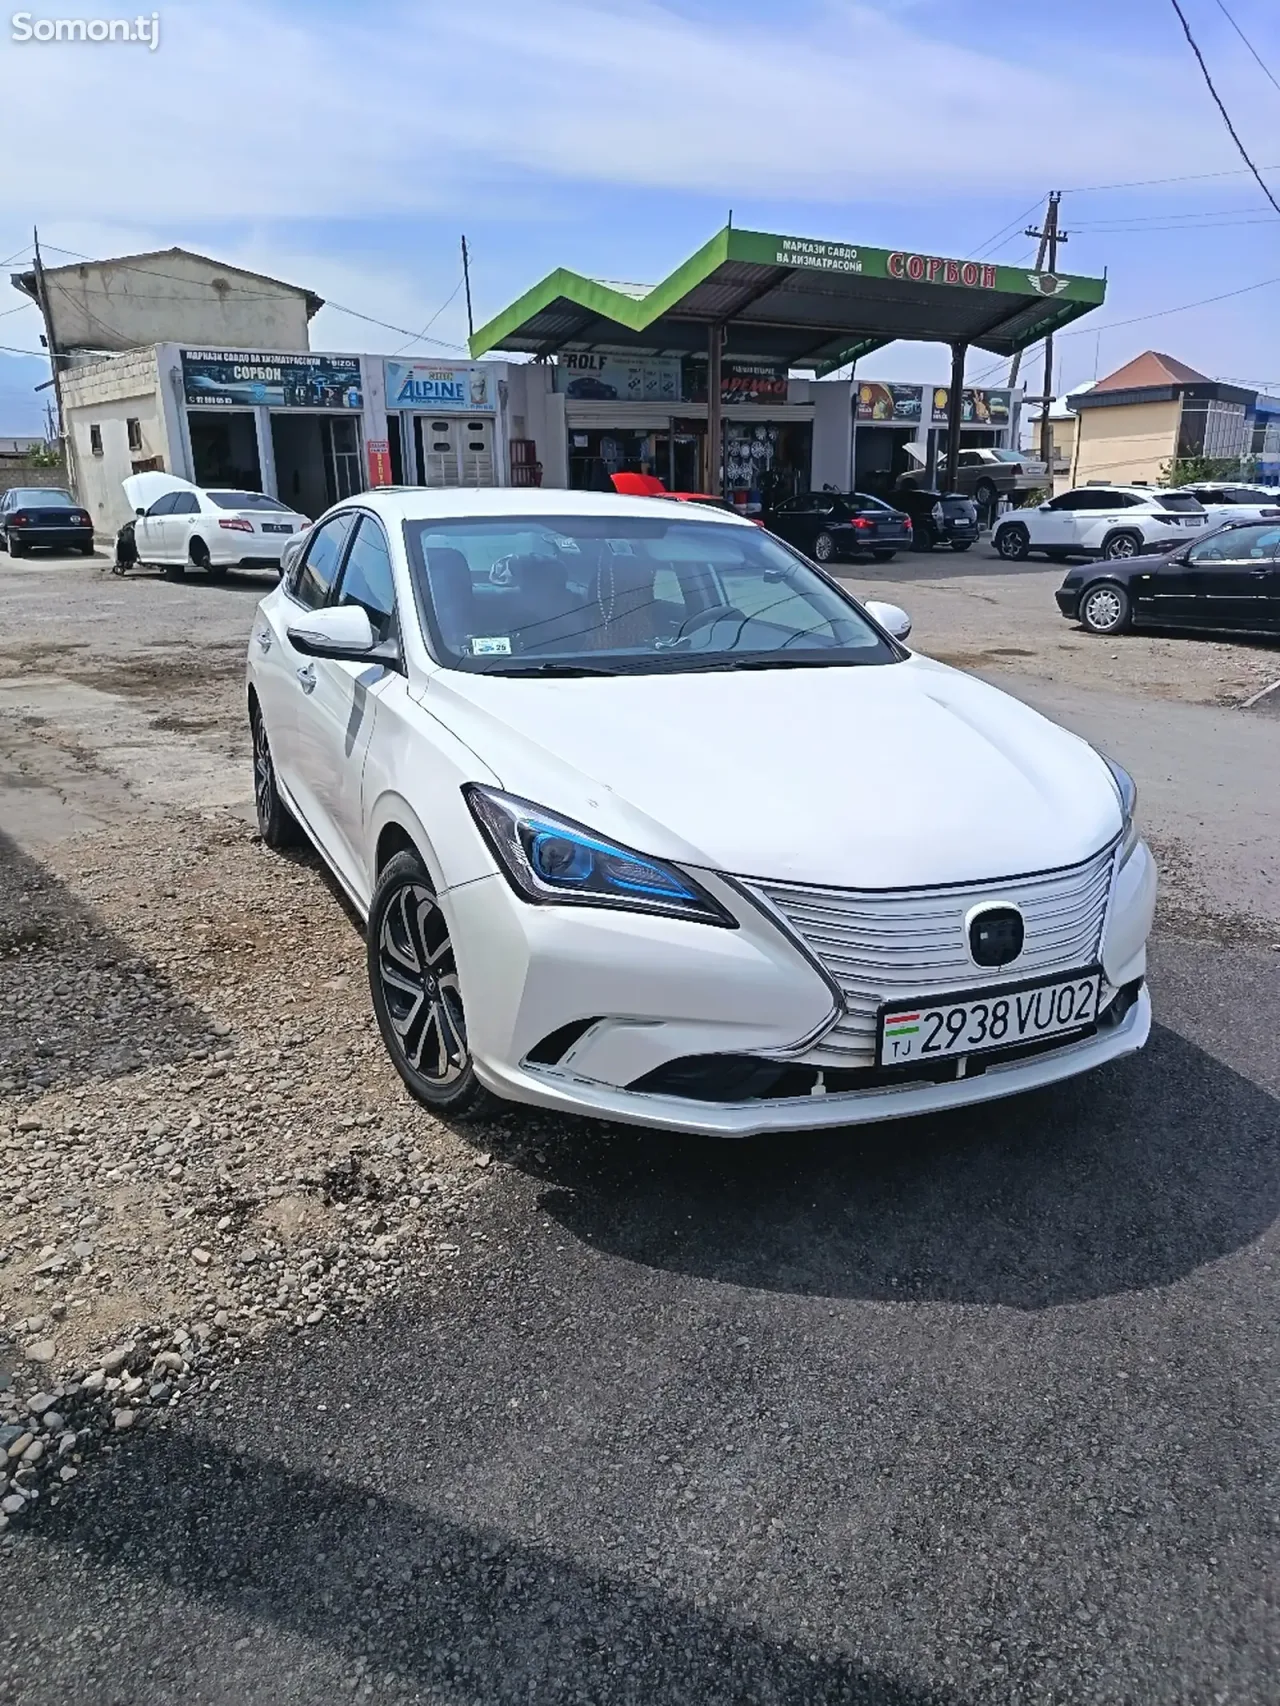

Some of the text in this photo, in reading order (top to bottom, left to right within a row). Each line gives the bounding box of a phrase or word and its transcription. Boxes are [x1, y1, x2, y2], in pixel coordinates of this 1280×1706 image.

[775, 252, 790, 264] ВА
[782, 239, 858, 260] МАРКАЗИ САВДО
[887, 251, 997, 289] СОРБОН
[564, 353, 608, 371] ROLF
[233, 365, 282, 381] СОРБОН
[397, 375, 465, 402] ALPINE
[891, 1040, 912, 1058] TJ
